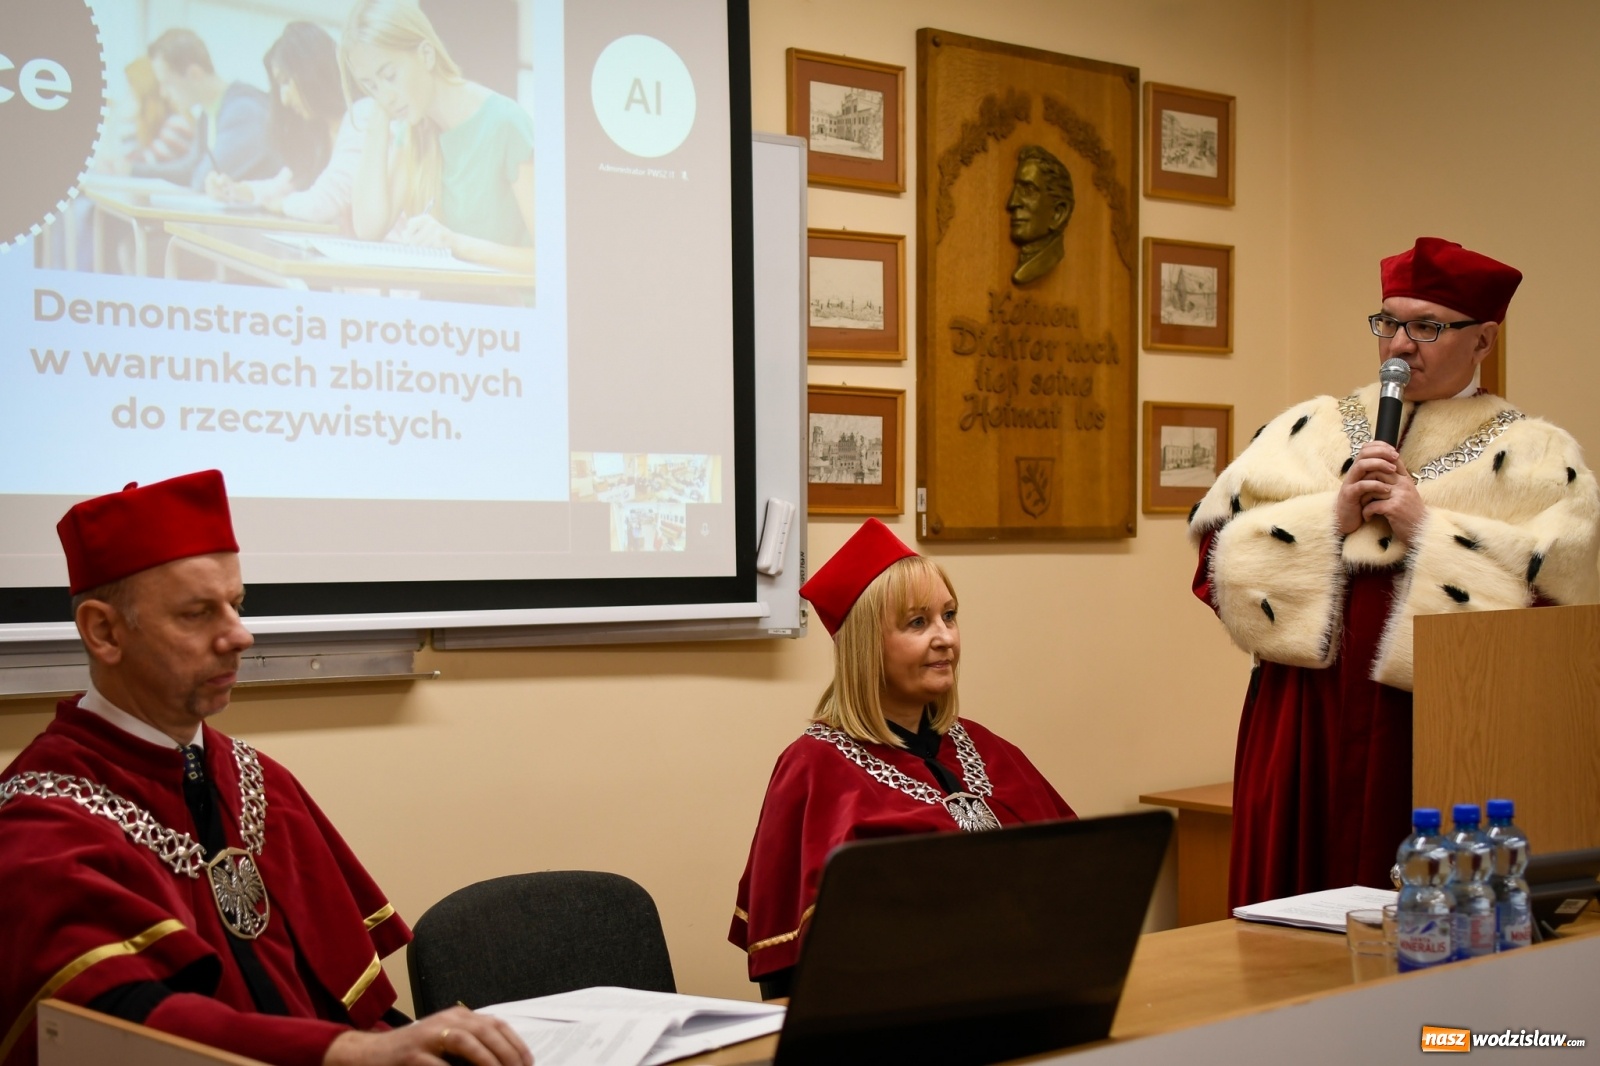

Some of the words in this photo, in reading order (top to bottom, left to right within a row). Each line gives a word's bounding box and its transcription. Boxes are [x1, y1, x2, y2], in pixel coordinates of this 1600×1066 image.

[624, 77, 662, 116] AI
[34, 288, 327, 346] Demonstracja
[340, 318, 521, 358] prototypu
[949, 317, 1059, 362] Dichter
[29, 348, 71, 375] w
[83, 351, 319, 388] warunkach
[329, 359, 523, 402] zbliżonych
[111, 396, 166, 430] do
[180, 404, 462, 446] rzeczywistych.
